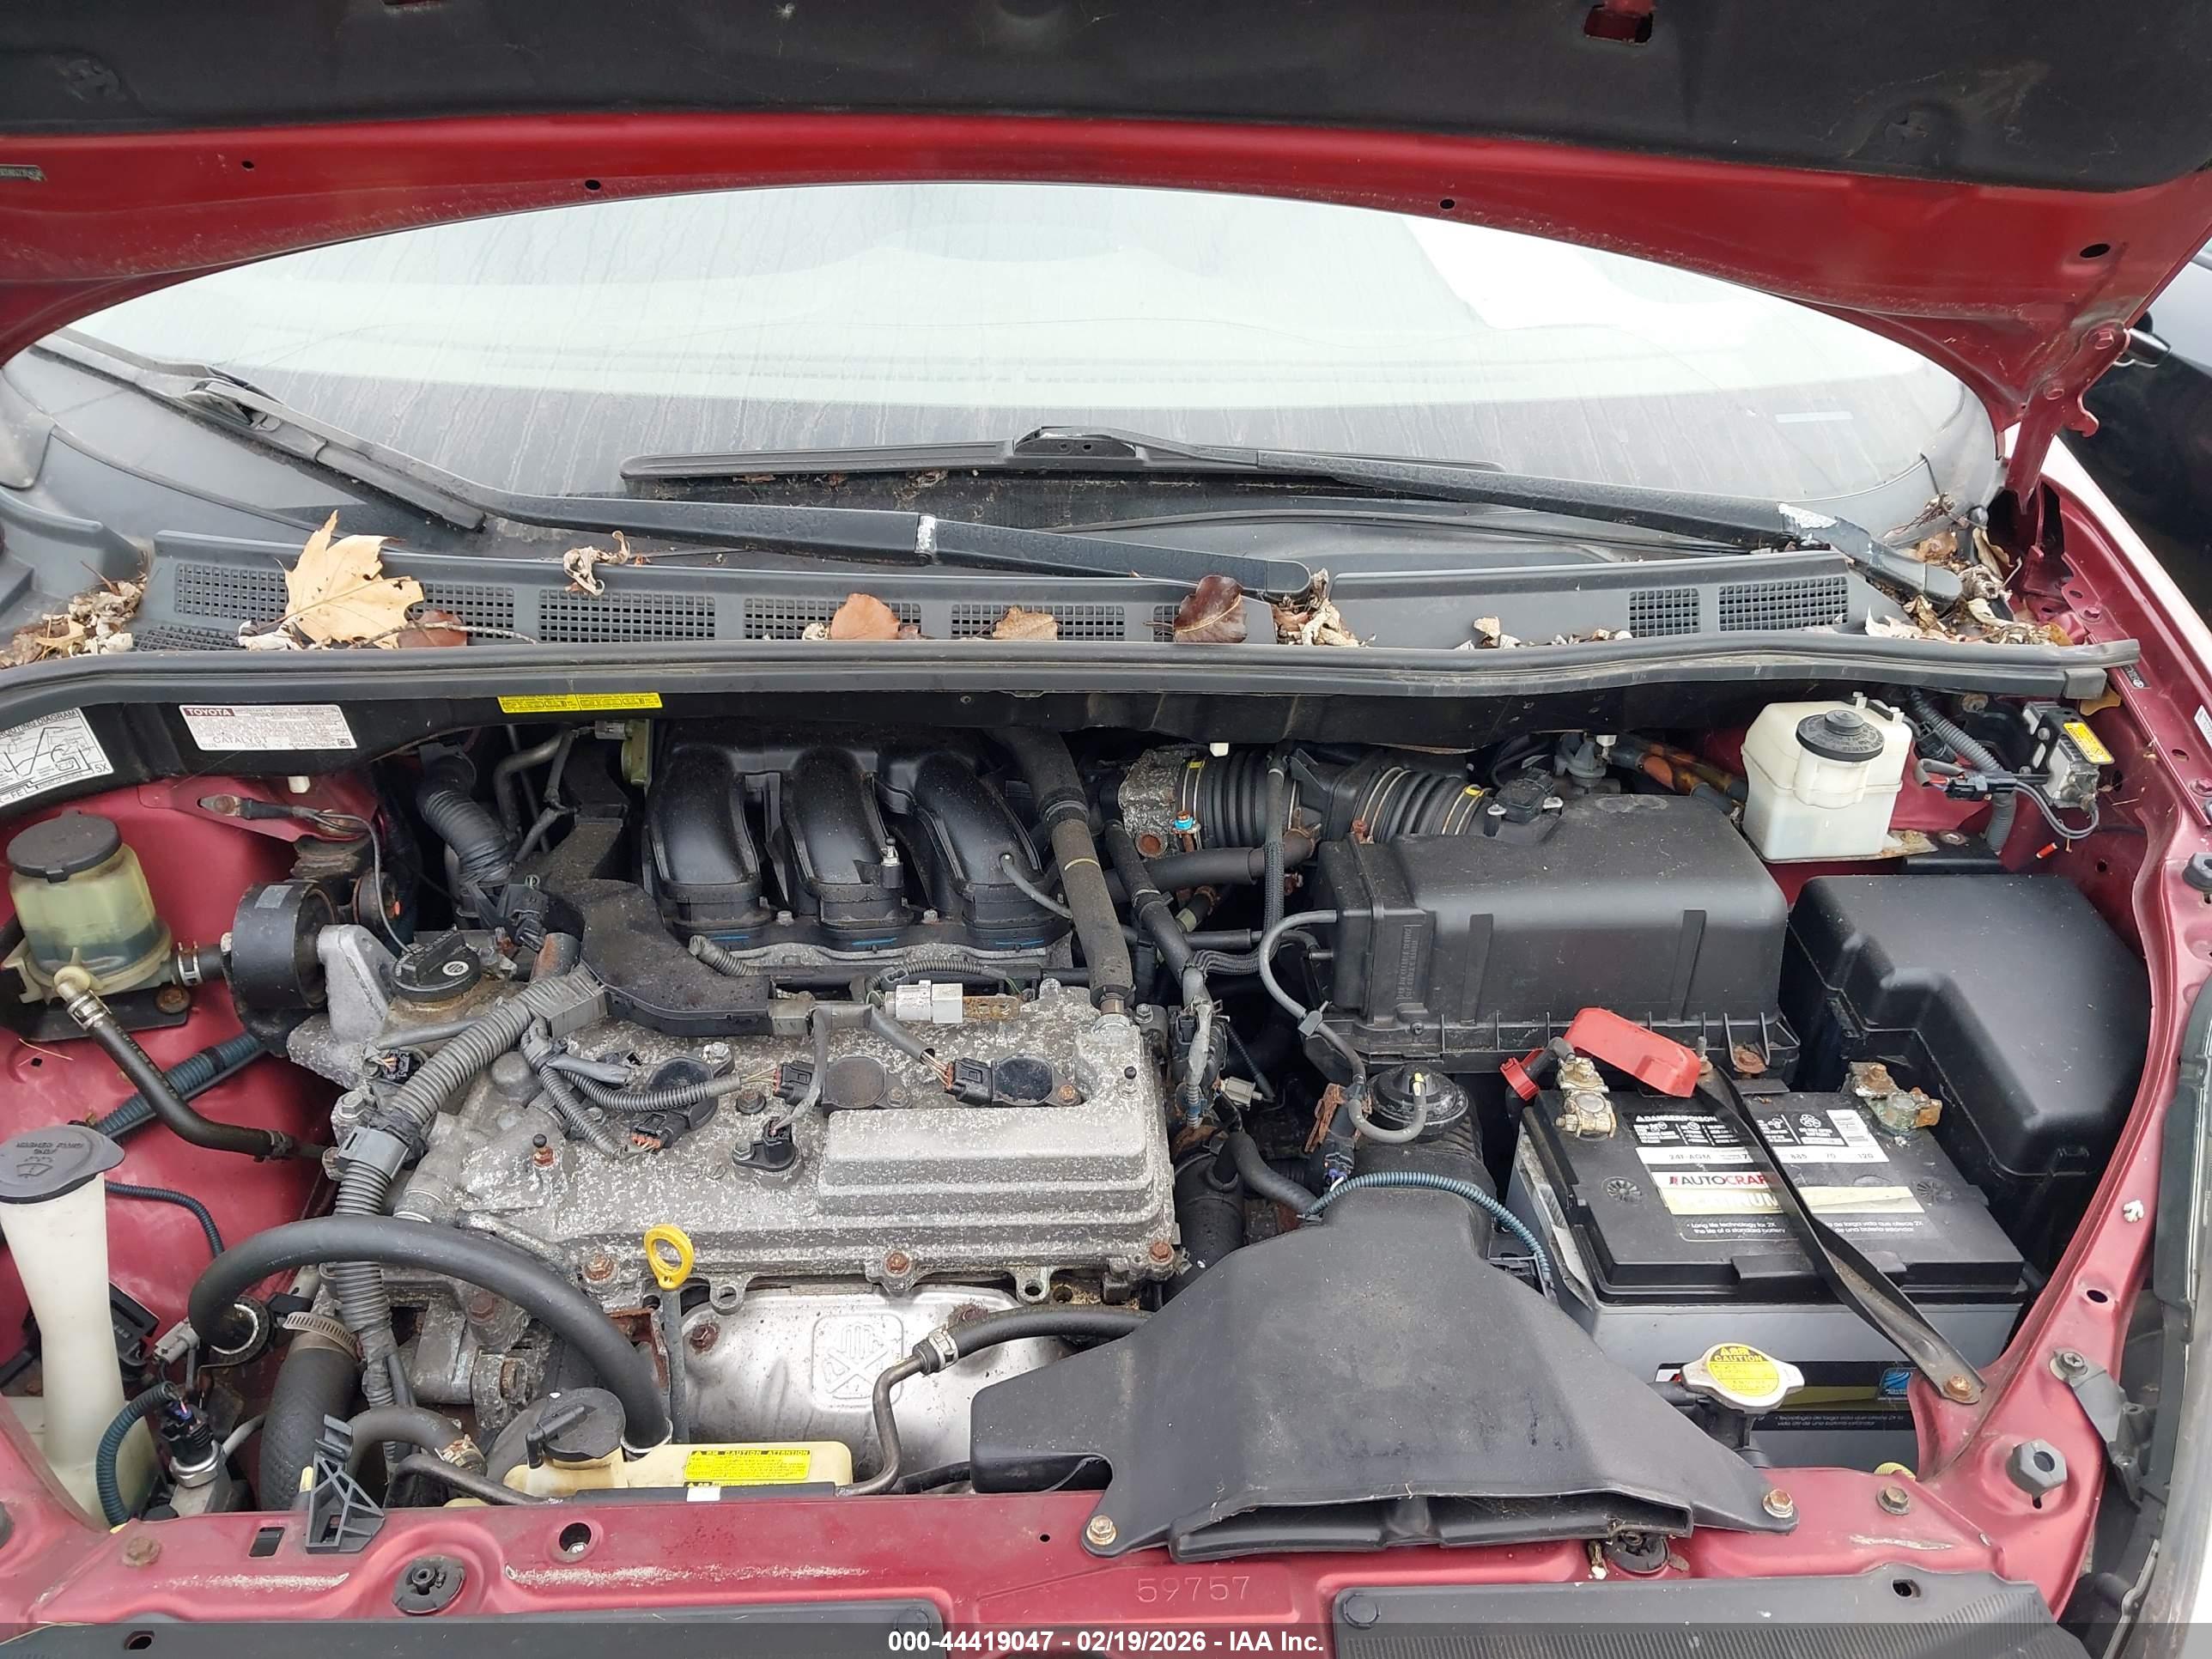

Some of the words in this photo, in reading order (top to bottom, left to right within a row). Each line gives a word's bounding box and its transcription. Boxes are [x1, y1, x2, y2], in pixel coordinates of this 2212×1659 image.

[38, 709, 77, 726] DIAGRAM
[94, 763, 111, 773] 5X
[1136, 1575, 1250, 1603] 59757
